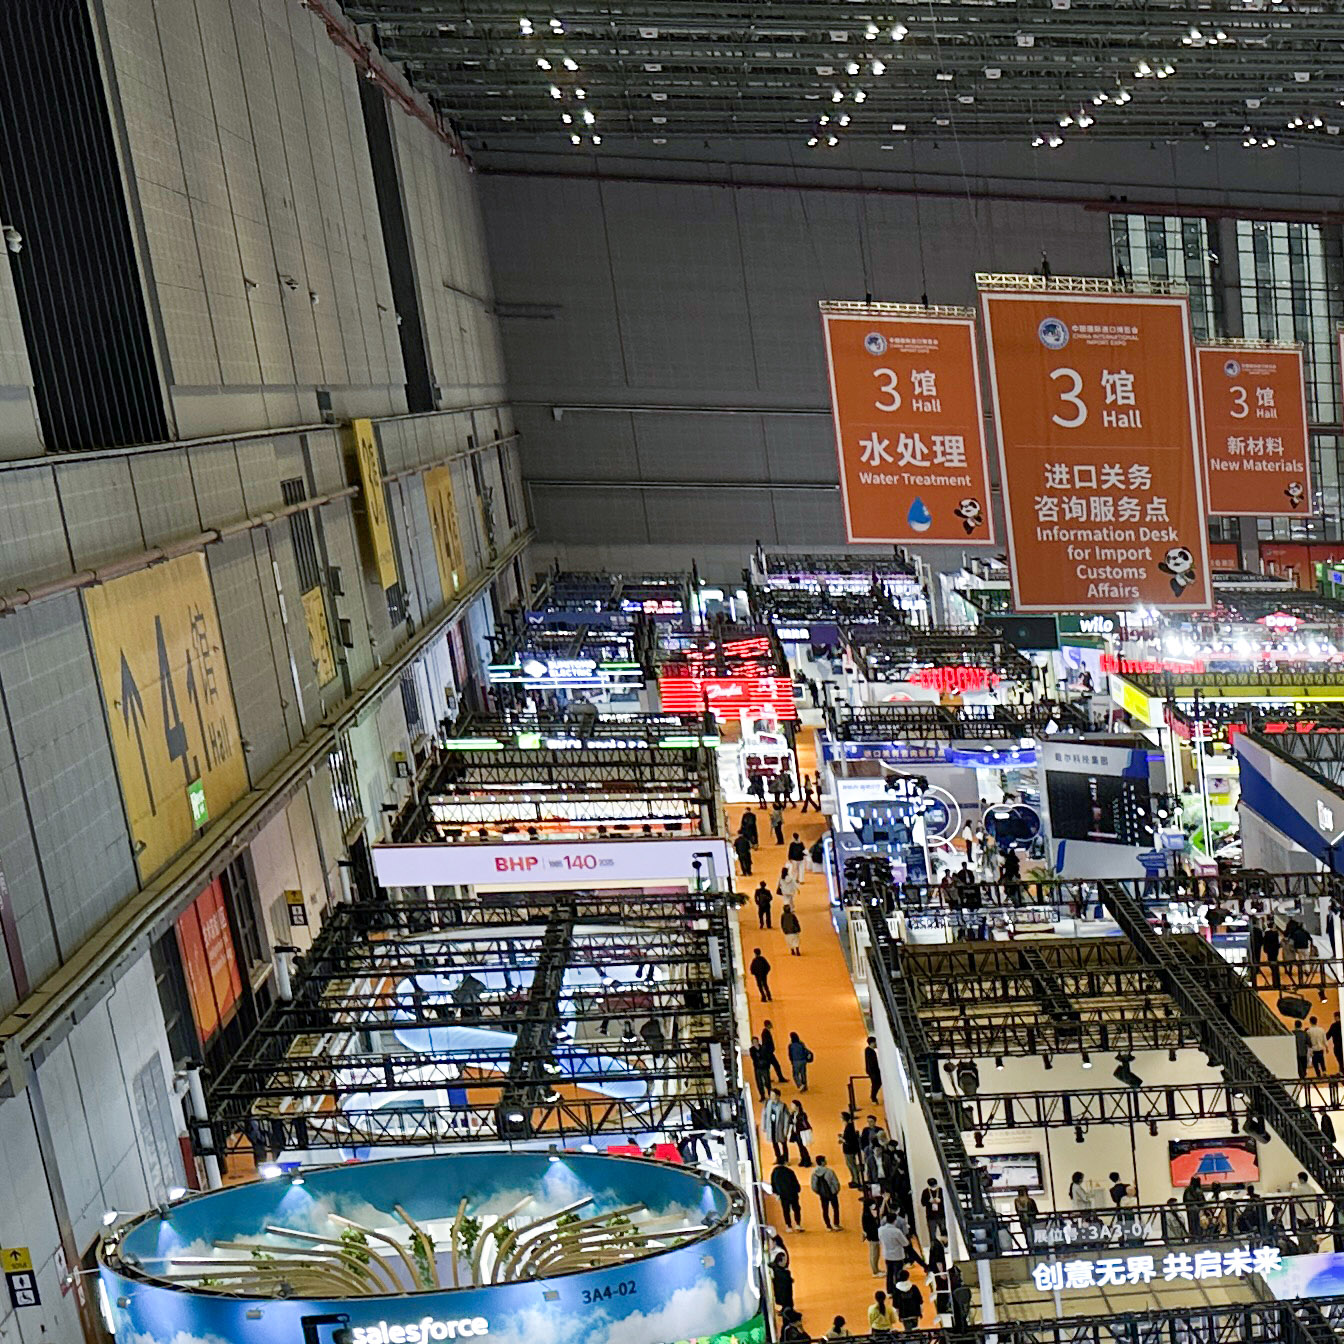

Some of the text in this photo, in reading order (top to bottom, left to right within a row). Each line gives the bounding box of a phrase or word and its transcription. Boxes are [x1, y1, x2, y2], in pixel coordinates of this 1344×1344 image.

[873, 368, 937, 412] 3 馆
[1050, 368, 1136, 428] 3 馆
[912, 399, 941, 413] Hall
[1229, 386, 1275, 418] 3 馆
[1103, 410, 1142, 428] Hall
[1256, 408, 1278, 419] Hall
[859, 432, 968, 468] 水处理
[1227, 436, 1284, 456] 新材料
[1210, 458, 1304, 472] New Materials
[859, 471, 971, 488] Water Treatment
[1044, 463, 1152, 490] 进口关务
[1034, 496, 1170, 522] 咨询服务点
[1036, 526, 1179, 542] Information Desk
[1067, 545, 1152, 564] for Import
[1076, 565, 1147, 580] Customs
[1087, 583, 1140, 599] Affairs
[1080, 616, 1114, 633] wilo
[207, 715, 230, 769] Hall
[495, 856, 538, 872] BHP
[563, 854, 597, 870] 140
[1032, 1245, 1283, 1293] 创意无界 共启未来
[581, 1279, 638, 1306] 3A4-02
